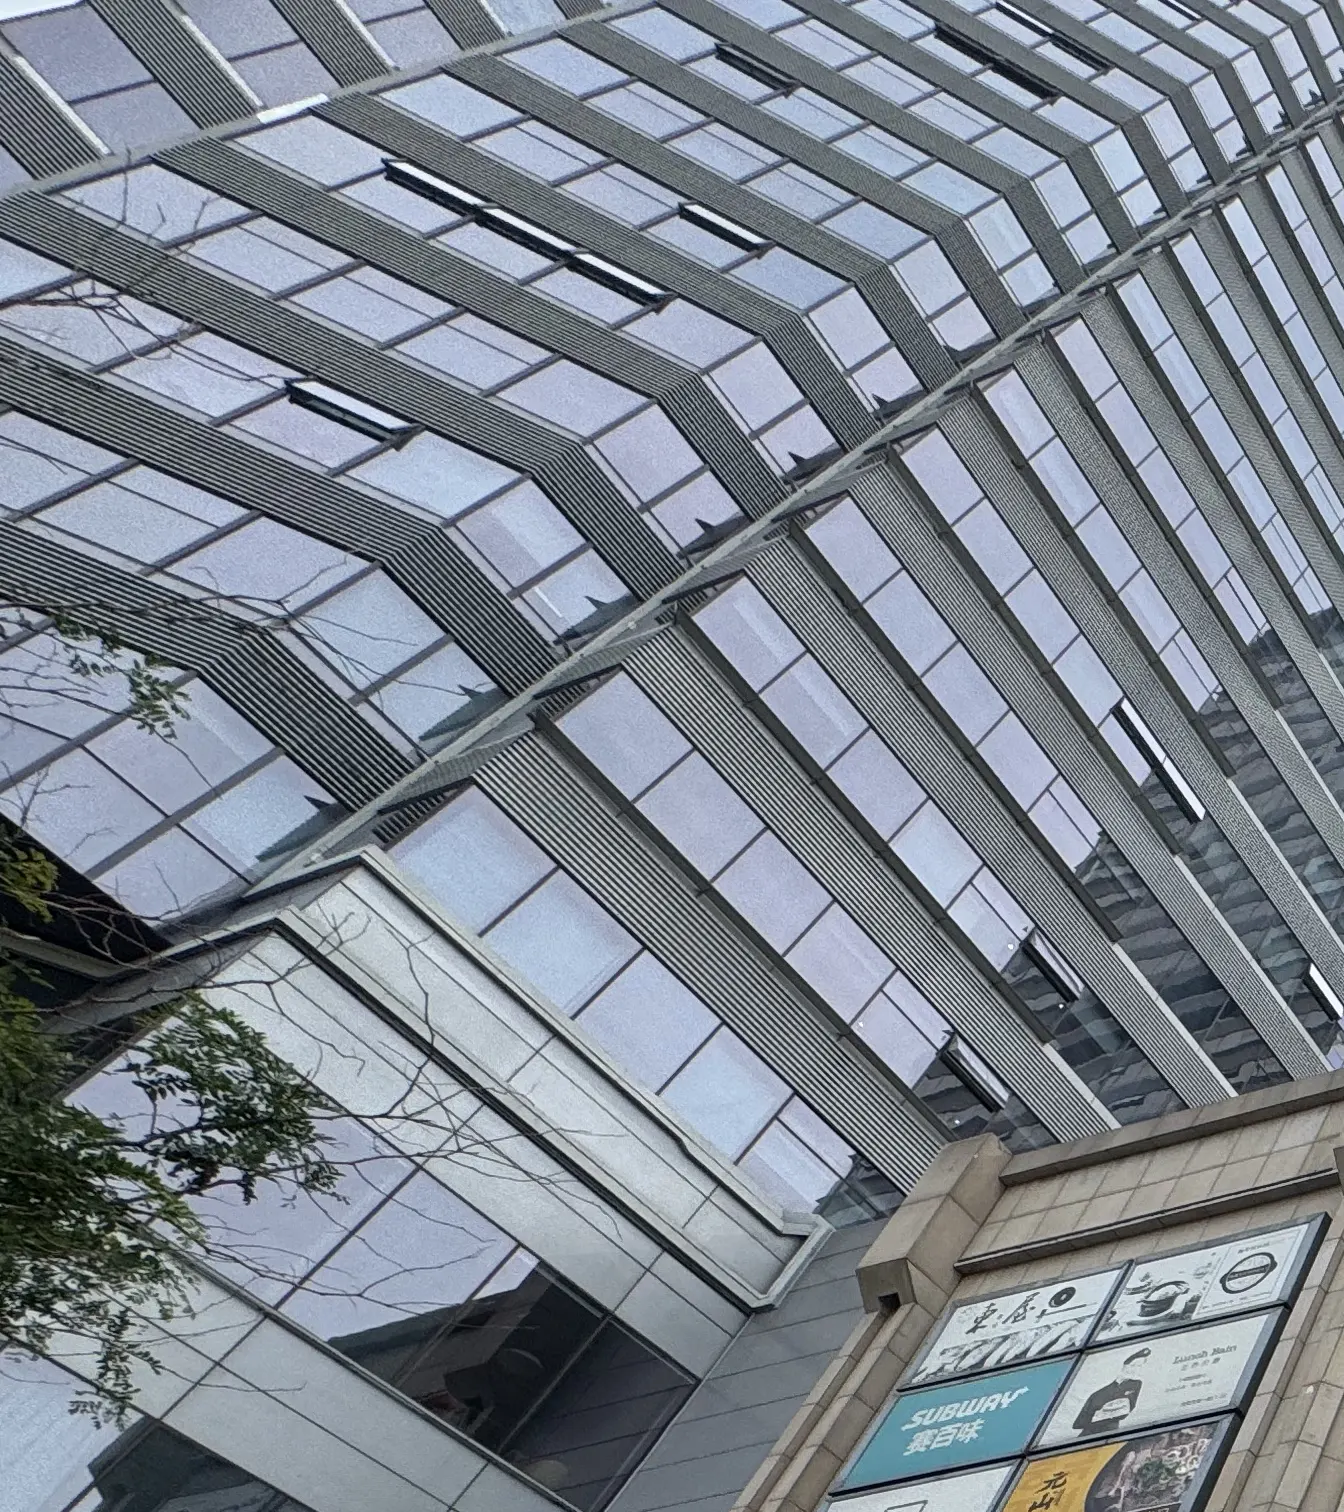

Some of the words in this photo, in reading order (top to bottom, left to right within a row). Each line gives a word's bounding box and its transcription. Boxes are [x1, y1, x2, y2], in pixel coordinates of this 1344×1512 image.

[900, 1386, 1030, 1431] SUBWAY
[902, 1418, 986, 1456] 赛百味
